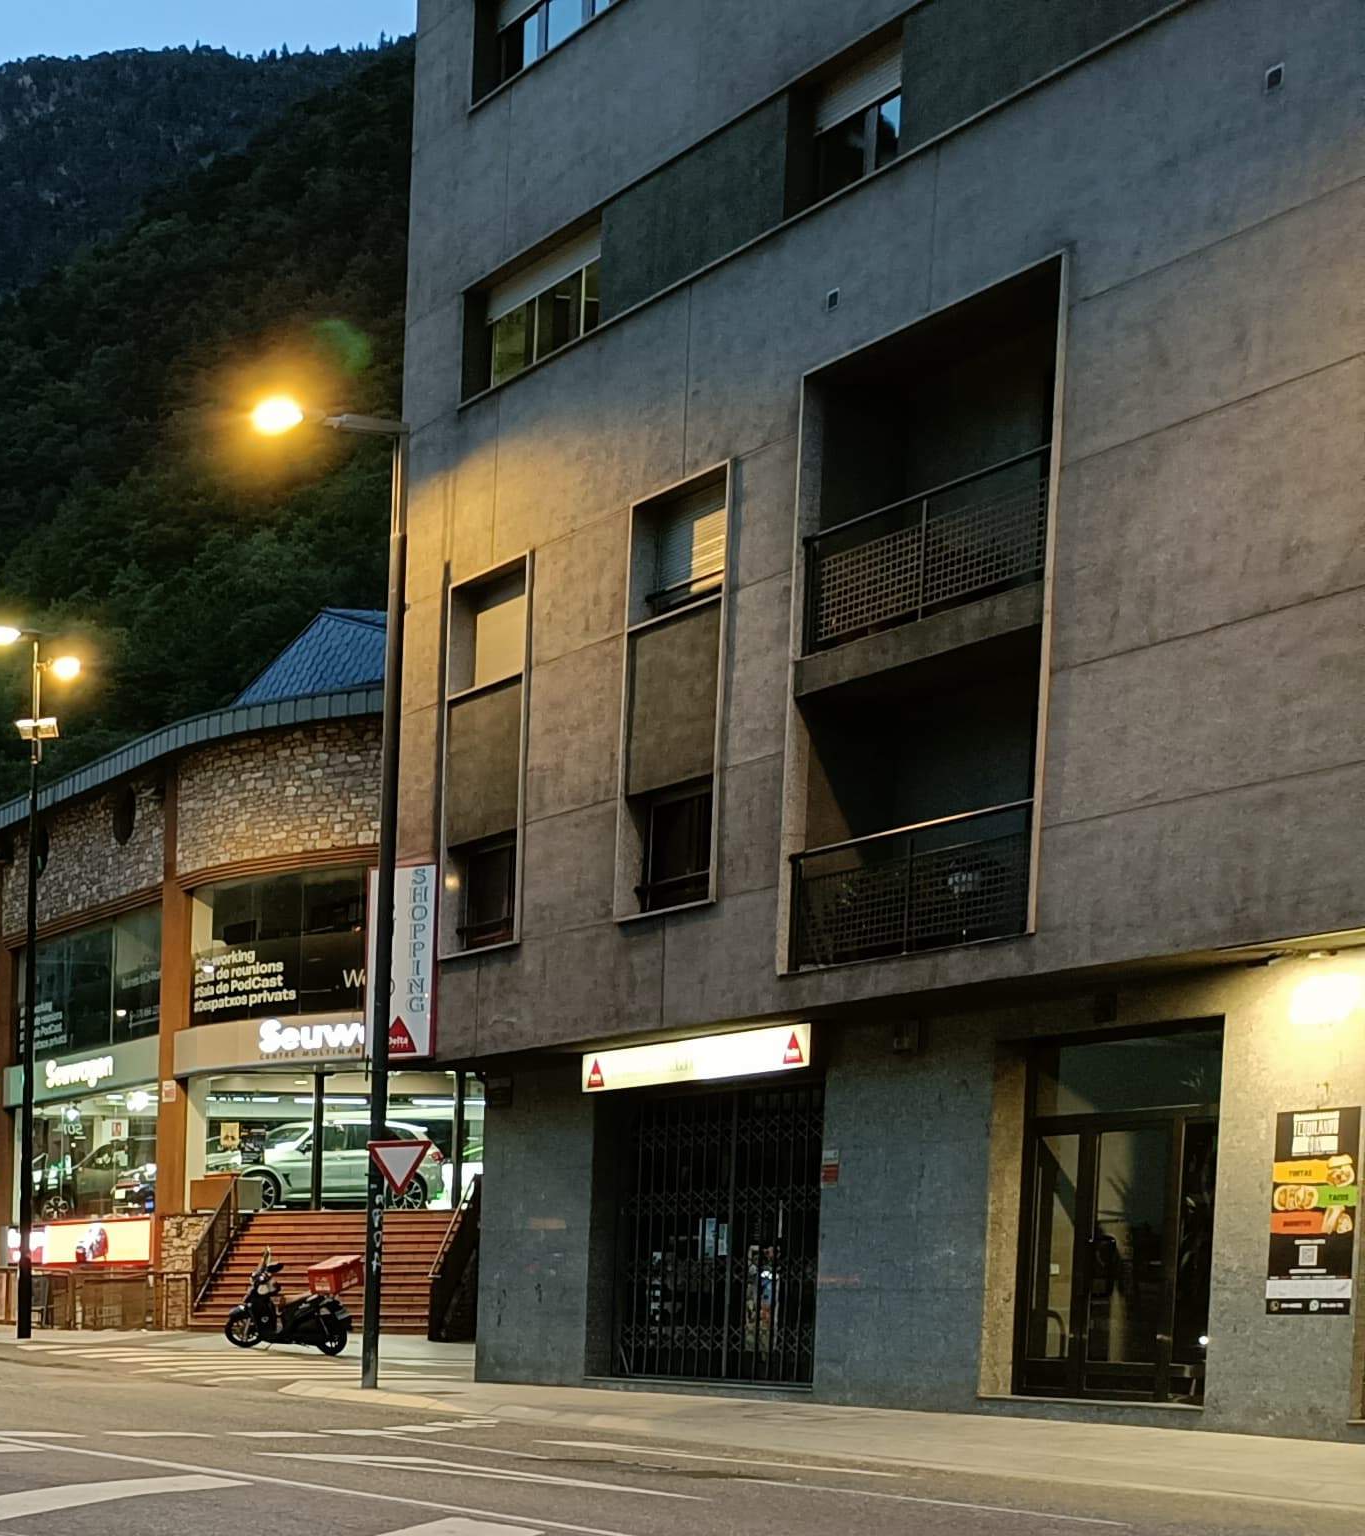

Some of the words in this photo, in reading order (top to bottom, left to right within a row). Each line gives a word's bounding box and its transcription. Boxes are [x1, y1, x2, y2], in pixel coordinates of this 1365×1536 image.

[407, 868, 429, 1013] SHOPPING
[216, 967, 230, 981] de
[231, 961, 284, 977] reunions
[216, 981, 230, 994] de
[231, 974, 284, 993] PodCast
[249, 989, 297, 1007] privats
[259, 1019, 365, 1053] Seuw
